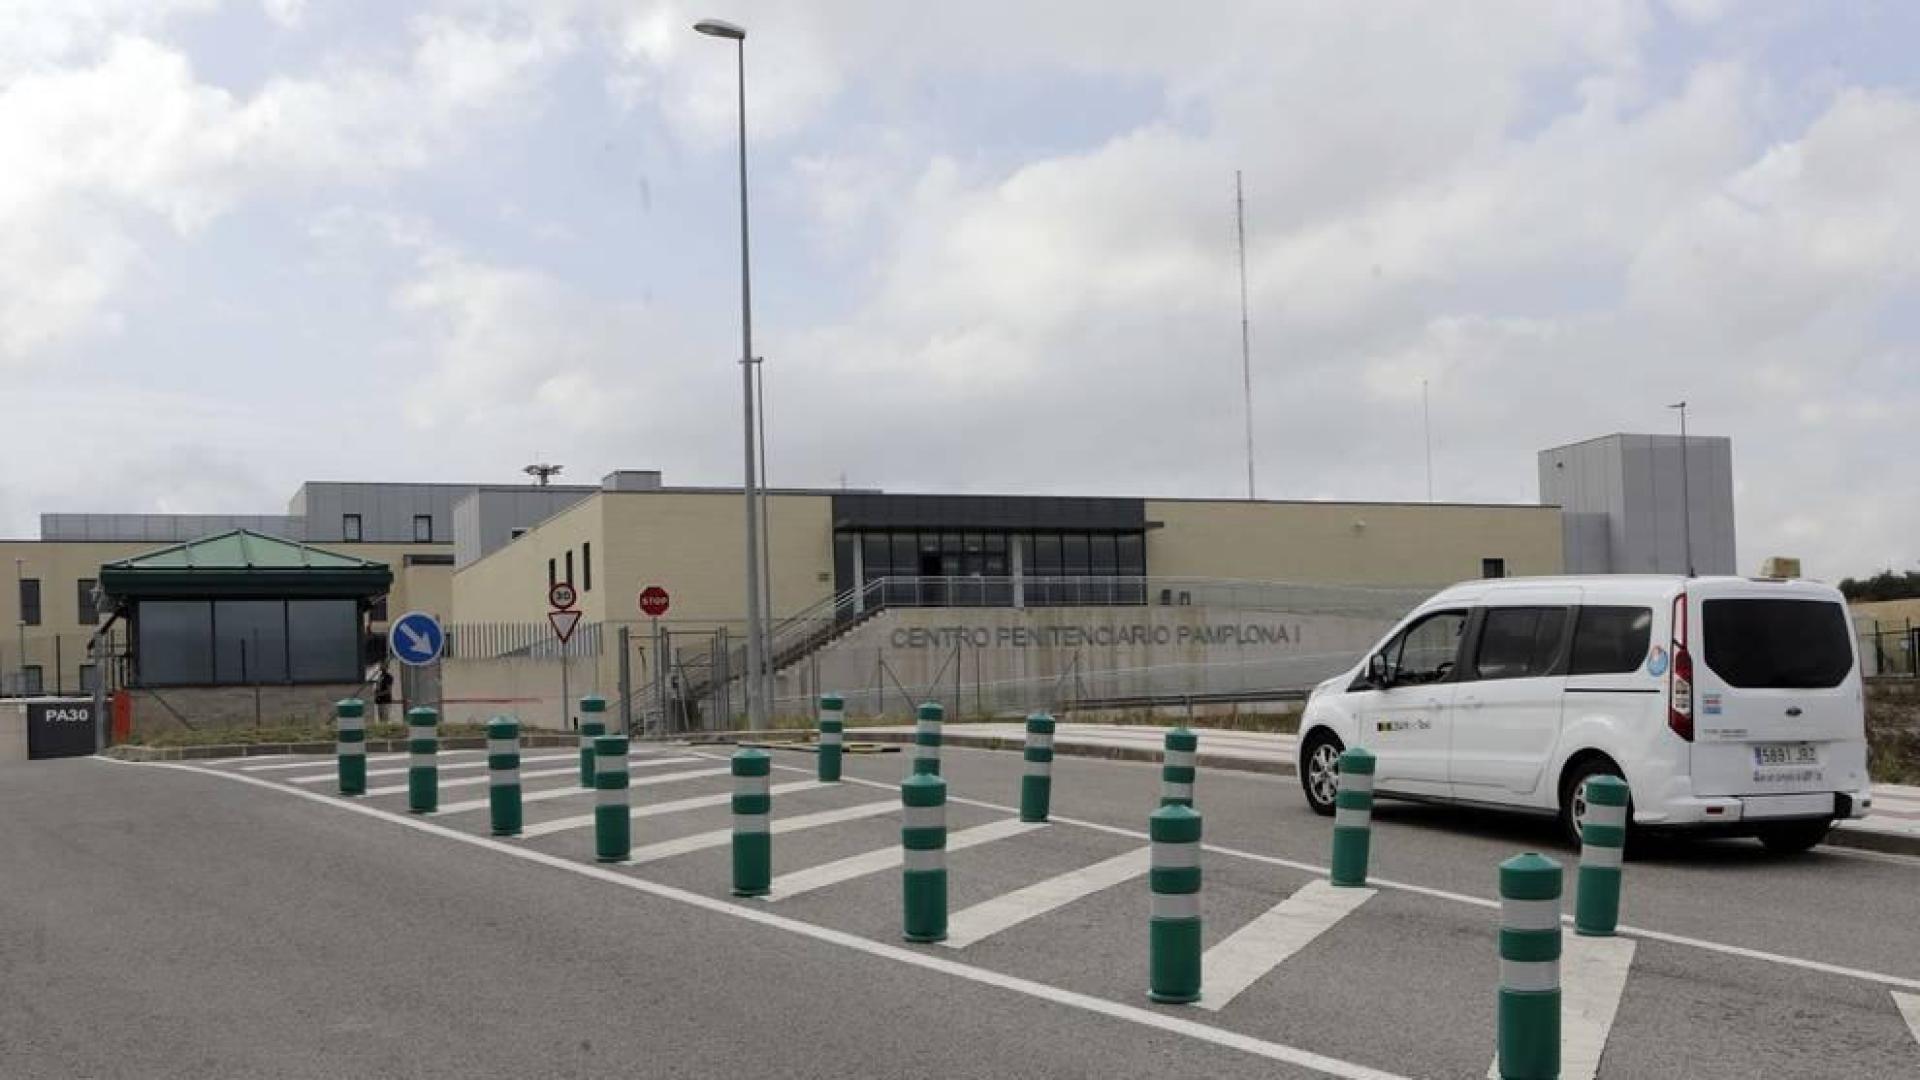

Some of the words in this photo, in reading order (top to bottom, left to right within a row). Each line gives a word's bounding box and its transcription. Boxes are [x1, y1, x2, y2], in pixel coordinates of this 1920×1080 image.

[556, 590, 571, 600] 30
[641, 596, 669, 606] STOP
[891, 626, 990, 648] CENTRO
[996, 625, 1171, 647] PENITENCIARIO
[1177, 624, 1290, 645] PAMPLONA
[45, 709, 88, 722] PA30
